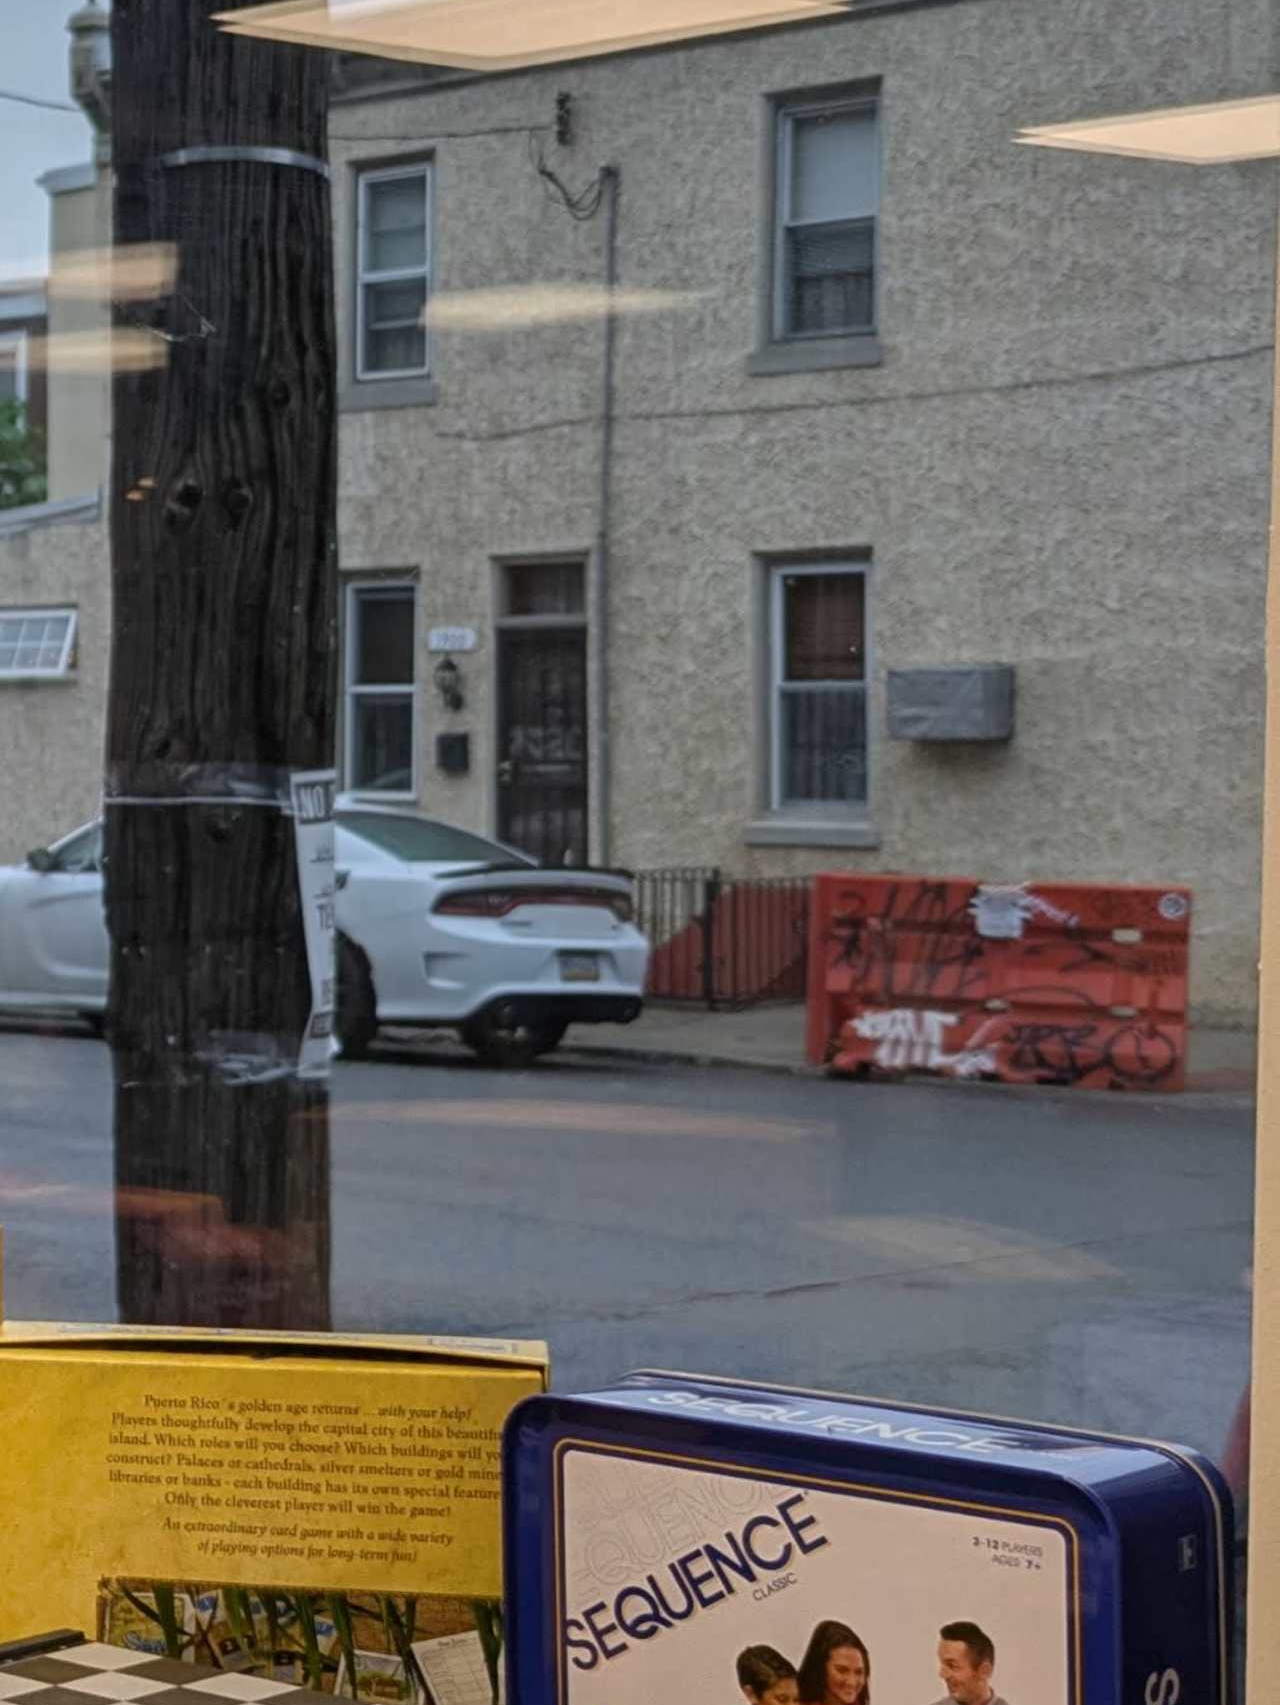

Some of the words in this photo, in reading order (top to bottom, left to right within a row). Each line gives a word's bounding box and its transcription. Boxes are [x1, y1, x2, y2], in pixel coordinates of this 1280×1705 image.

[111, 1412, 157, 1427] Players
[161, 1414, 240, 1432] thoughtfully
[244, 1418, 295, 1435] develop
[298, 1421, 320, 1434] the
[323, 1423, 368, 1437] capital
[371, 1425, 397, 1438] city
[400, 1425, 415, 1438] of
[417, 1427, 442, 1439] this
[647, 1390, 1026, 1455] SEQUENCE
[164, 1491, 197, 1508] Only
[201, 1492, 220, 1506] the
[225, 1493, 282, 1511] cleverest
[284, 1498, 324, 1514] player
[327, 1499, 353, 1512] will
[356, 1501, 381, 1513] win
[384, 1501, 409, 1515] the
[409, 1504, 452, 1518] game!
[162, 1517, 181, 1531] An
[184, 1519, 268, 1537] extraordinary
[270, 1523, 297, 1537] card
[299, 1526, 333, 1541] game
[336, 1526, 365, 1541] with
[366, 1531, 375, 1540] a
[378, 1529, 408, 1543] wide
[410, 1531, 455, 1546] variety
[1024, 1558, 1042, 1571] 7+
[565, 1491, 830, 1672] SEQUENCE
[752, 1571, 798, 1602] CLASSIC
